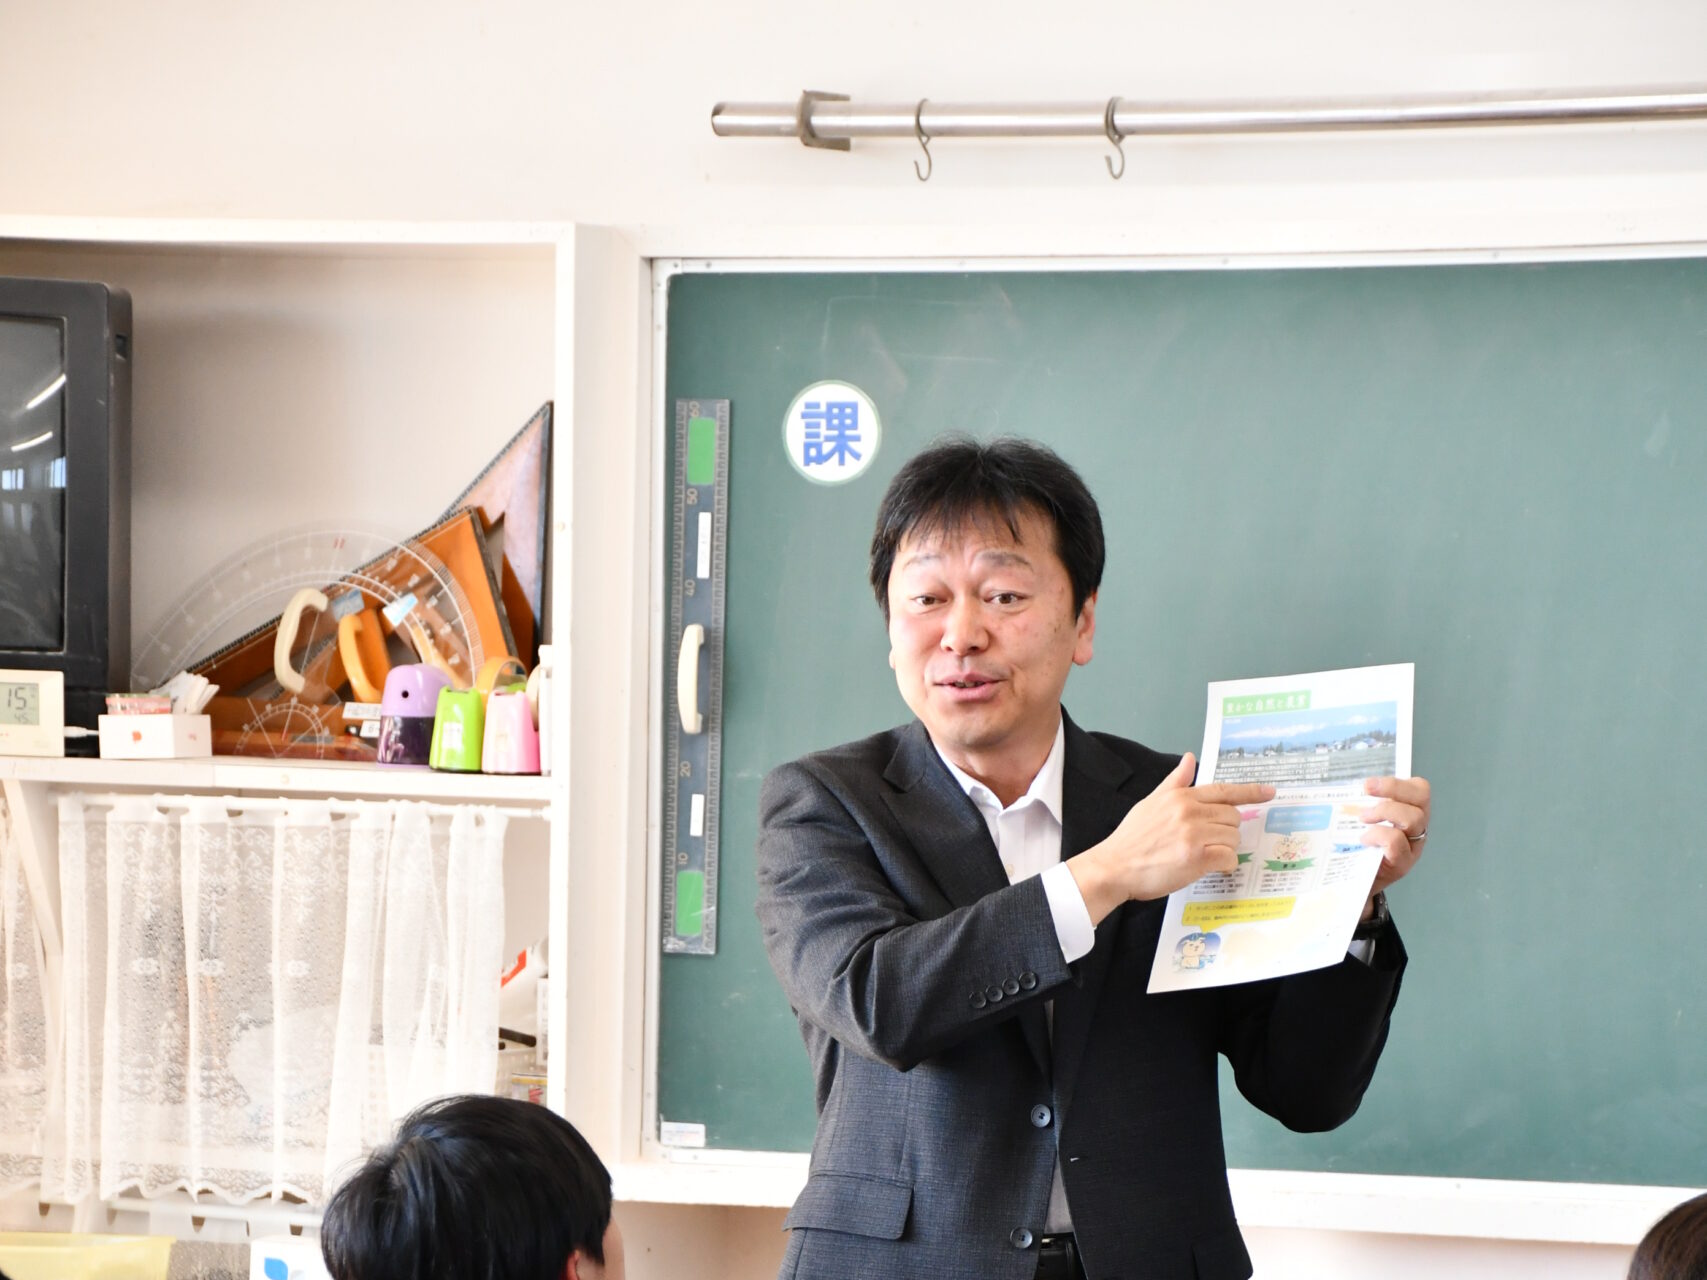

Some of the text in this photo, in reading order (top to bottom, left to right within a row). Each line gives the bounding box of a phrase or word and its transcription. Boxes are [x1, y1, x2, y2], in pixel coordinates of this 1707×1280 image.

[801, 401, 862, 467] 課
[686, 487, 699, 506] 50
[684, 578, 696, 598] 40
[8, 686, 28, 711] 15
[680, 760, 692, 778] 20
[678, 852, 689, 865] 10
